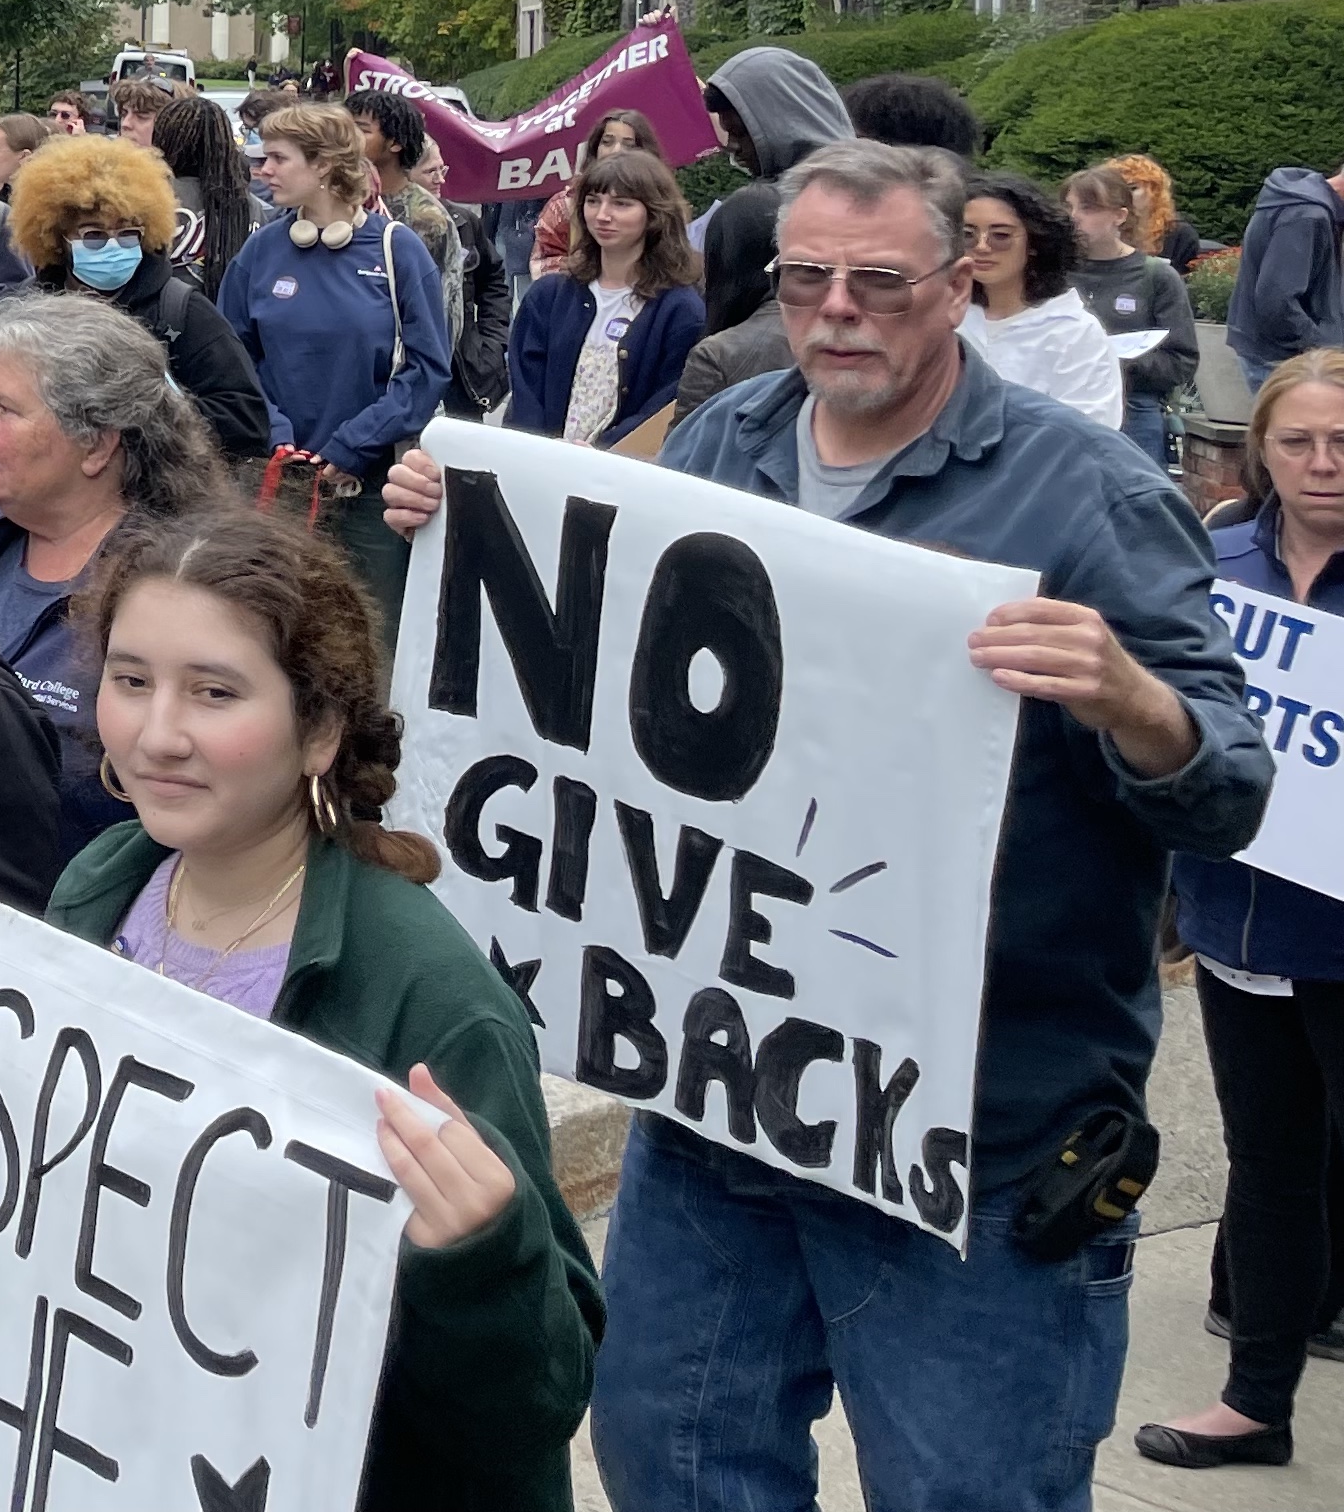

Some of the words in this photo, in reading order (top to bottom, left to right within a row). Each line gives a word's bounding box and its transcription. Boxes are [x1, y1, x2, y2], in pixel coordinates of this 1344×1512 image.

[517, 34, 669, 133] TOGETHER
[544, 107, 576, 135] at
[40, 680, 80, 701] College
[427, 465, 783, 803] NO
[443, 754, 813, 1000] GIVE
[577, 944, 968, 1236] BACKS
